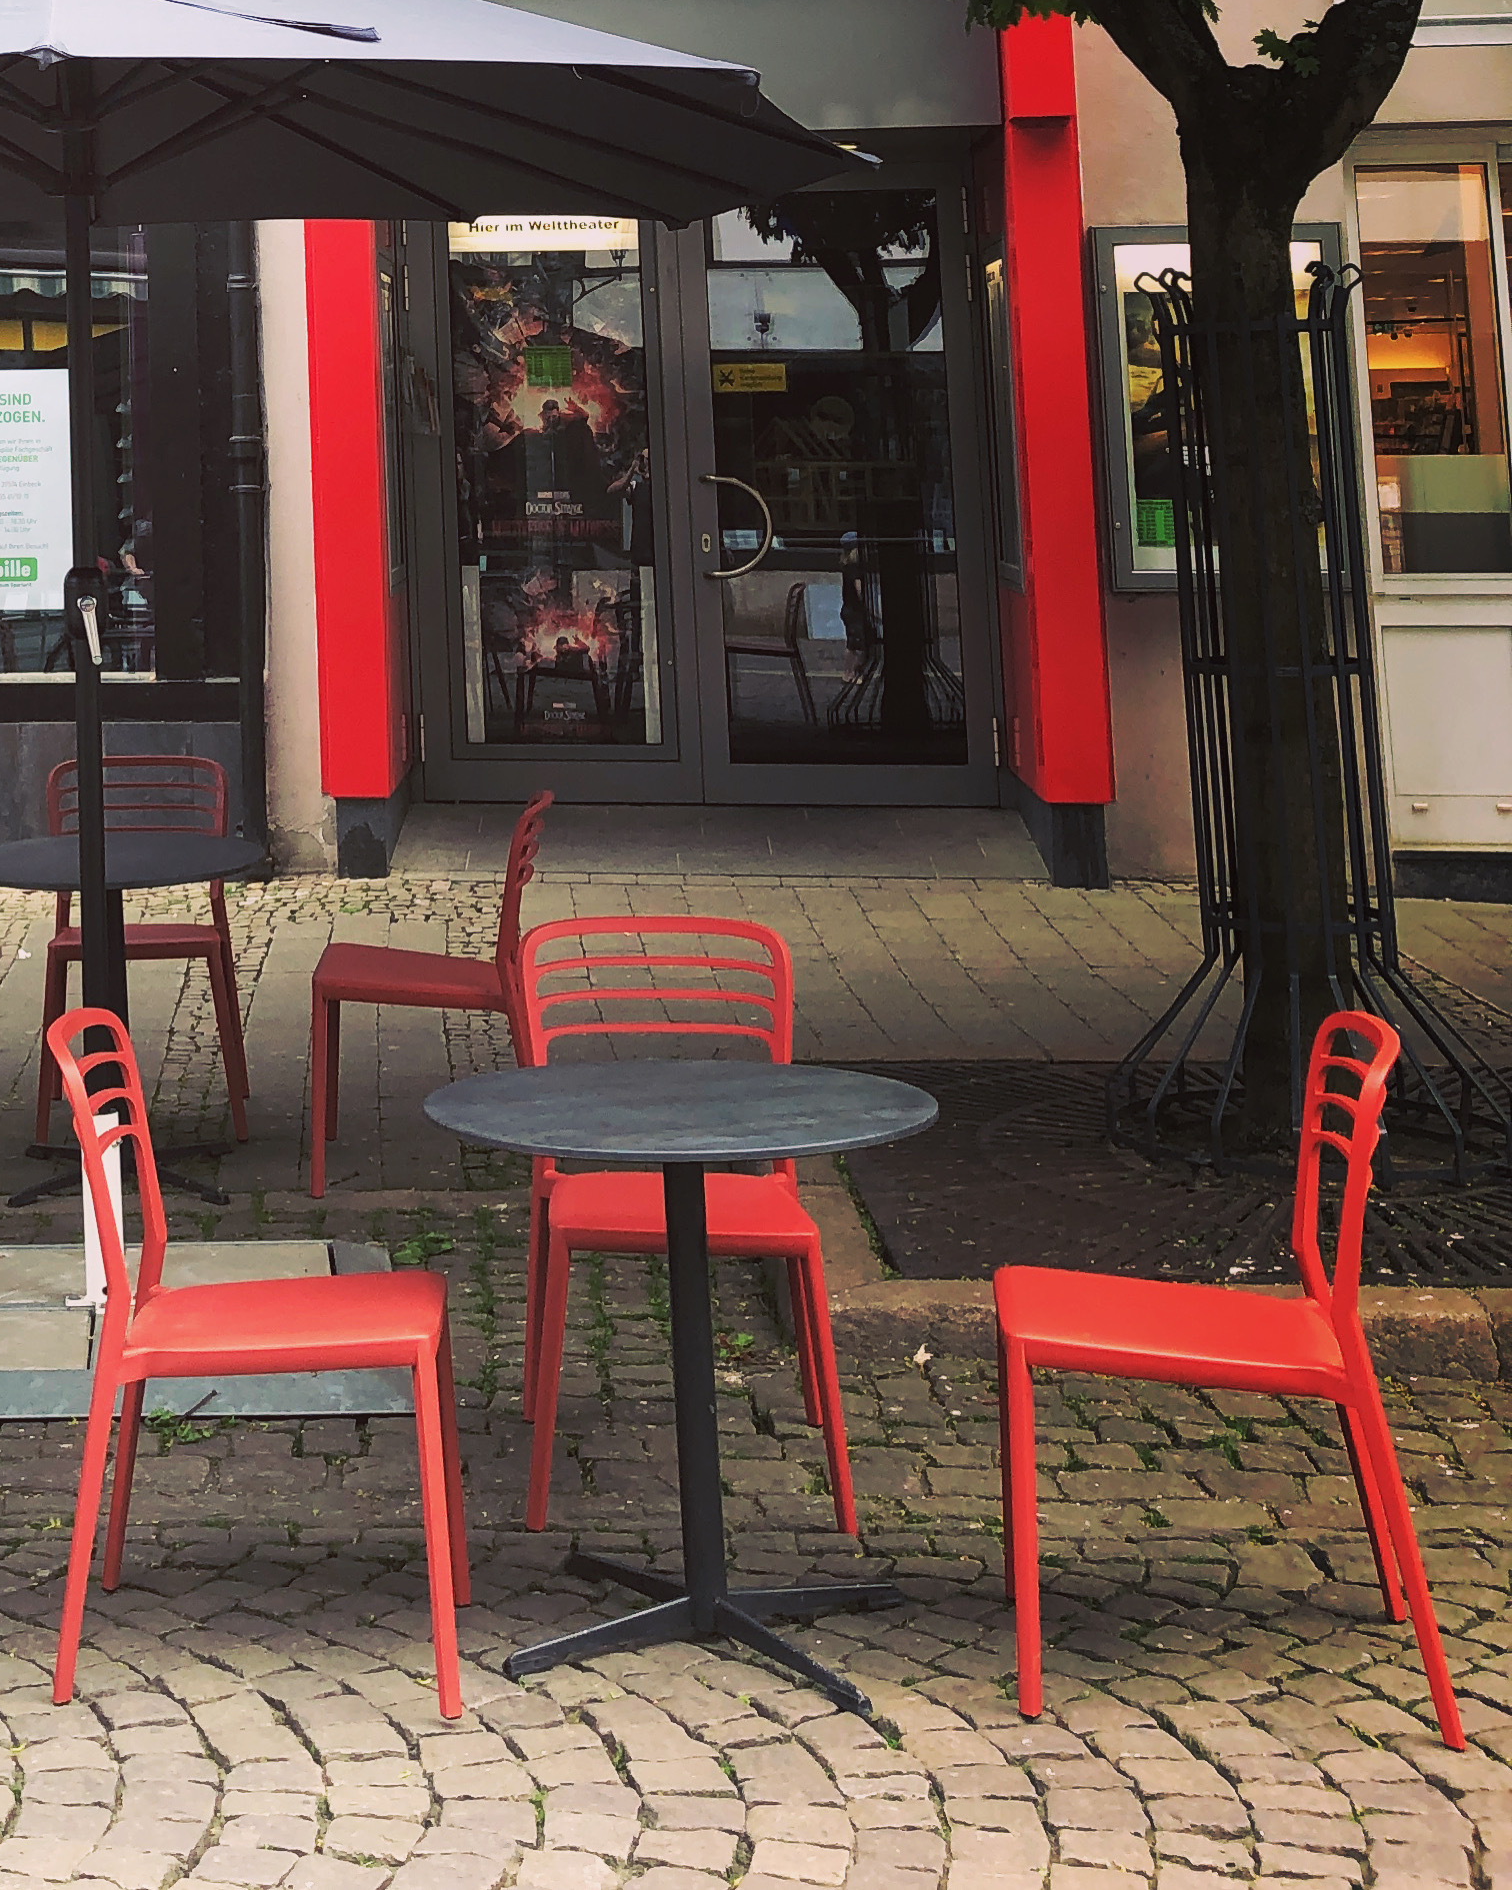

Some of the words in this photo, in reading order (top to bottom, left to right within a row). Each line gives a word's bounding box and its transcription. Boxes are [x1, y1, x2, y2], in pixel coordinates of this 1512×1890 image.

[468, 222, 500, 233] Hier
[505, 222, 523, 232] im
[528, 219, 619, 231] Welttheater
